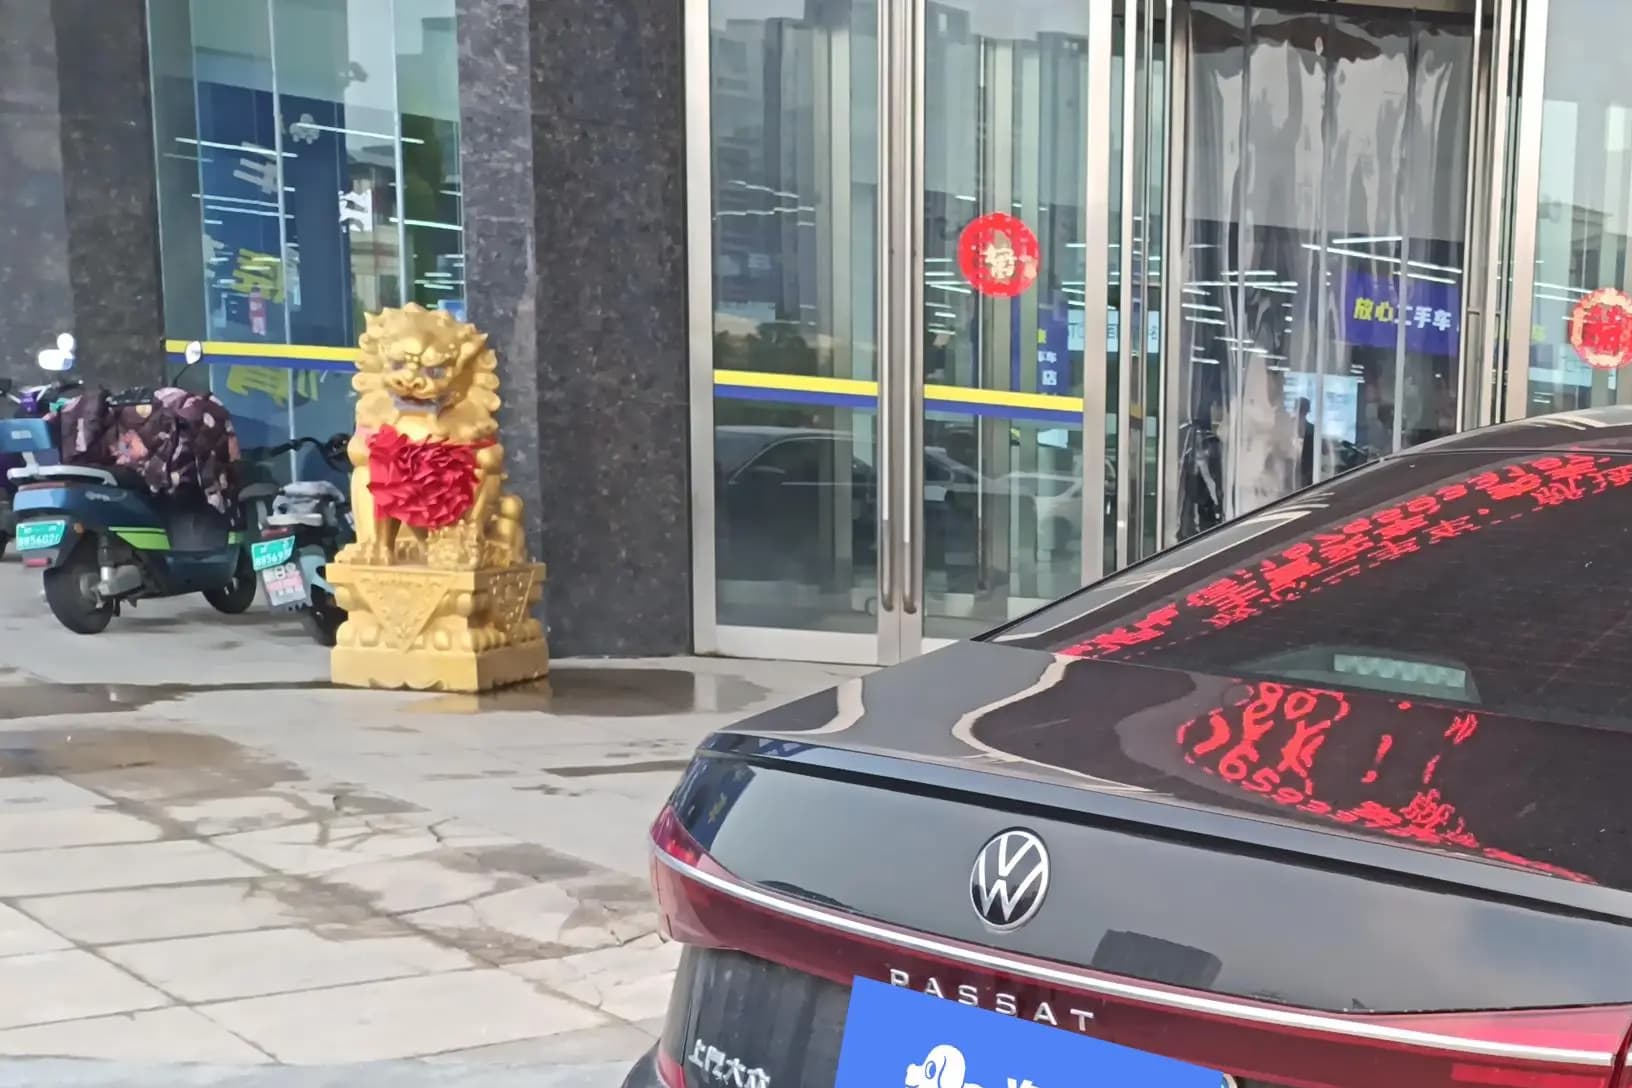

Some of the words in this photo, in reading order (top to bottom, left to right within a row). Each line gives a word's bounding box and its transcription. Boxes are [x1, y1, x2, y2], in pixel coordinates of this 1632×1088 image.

[1353, 297, 1452, 331] 放心二手车
[889, 968, 1095, 1032] PASSAT
